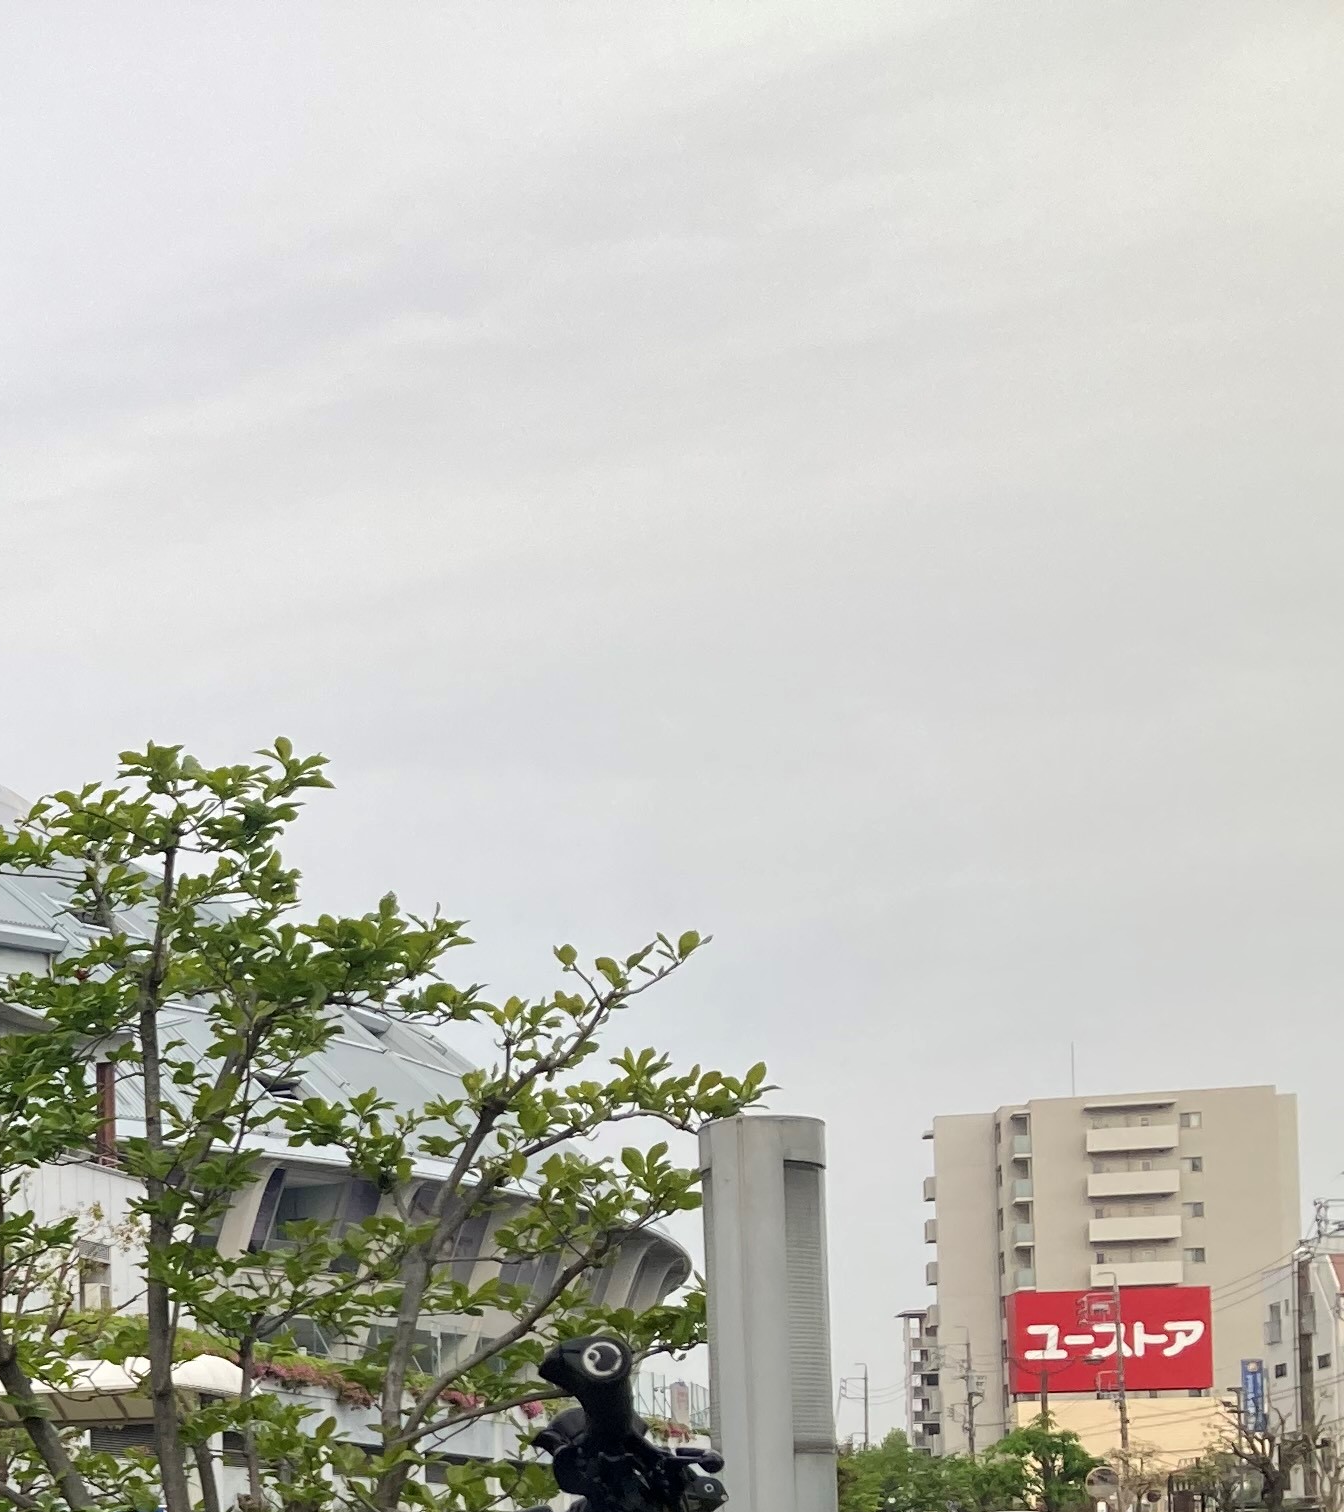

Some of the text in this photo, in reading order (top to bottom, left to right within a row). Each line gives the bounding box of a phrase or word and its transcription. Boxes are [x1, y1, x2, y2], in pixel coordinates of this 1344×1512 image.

[1024, 1320, 1205, 1360] ユーストア
